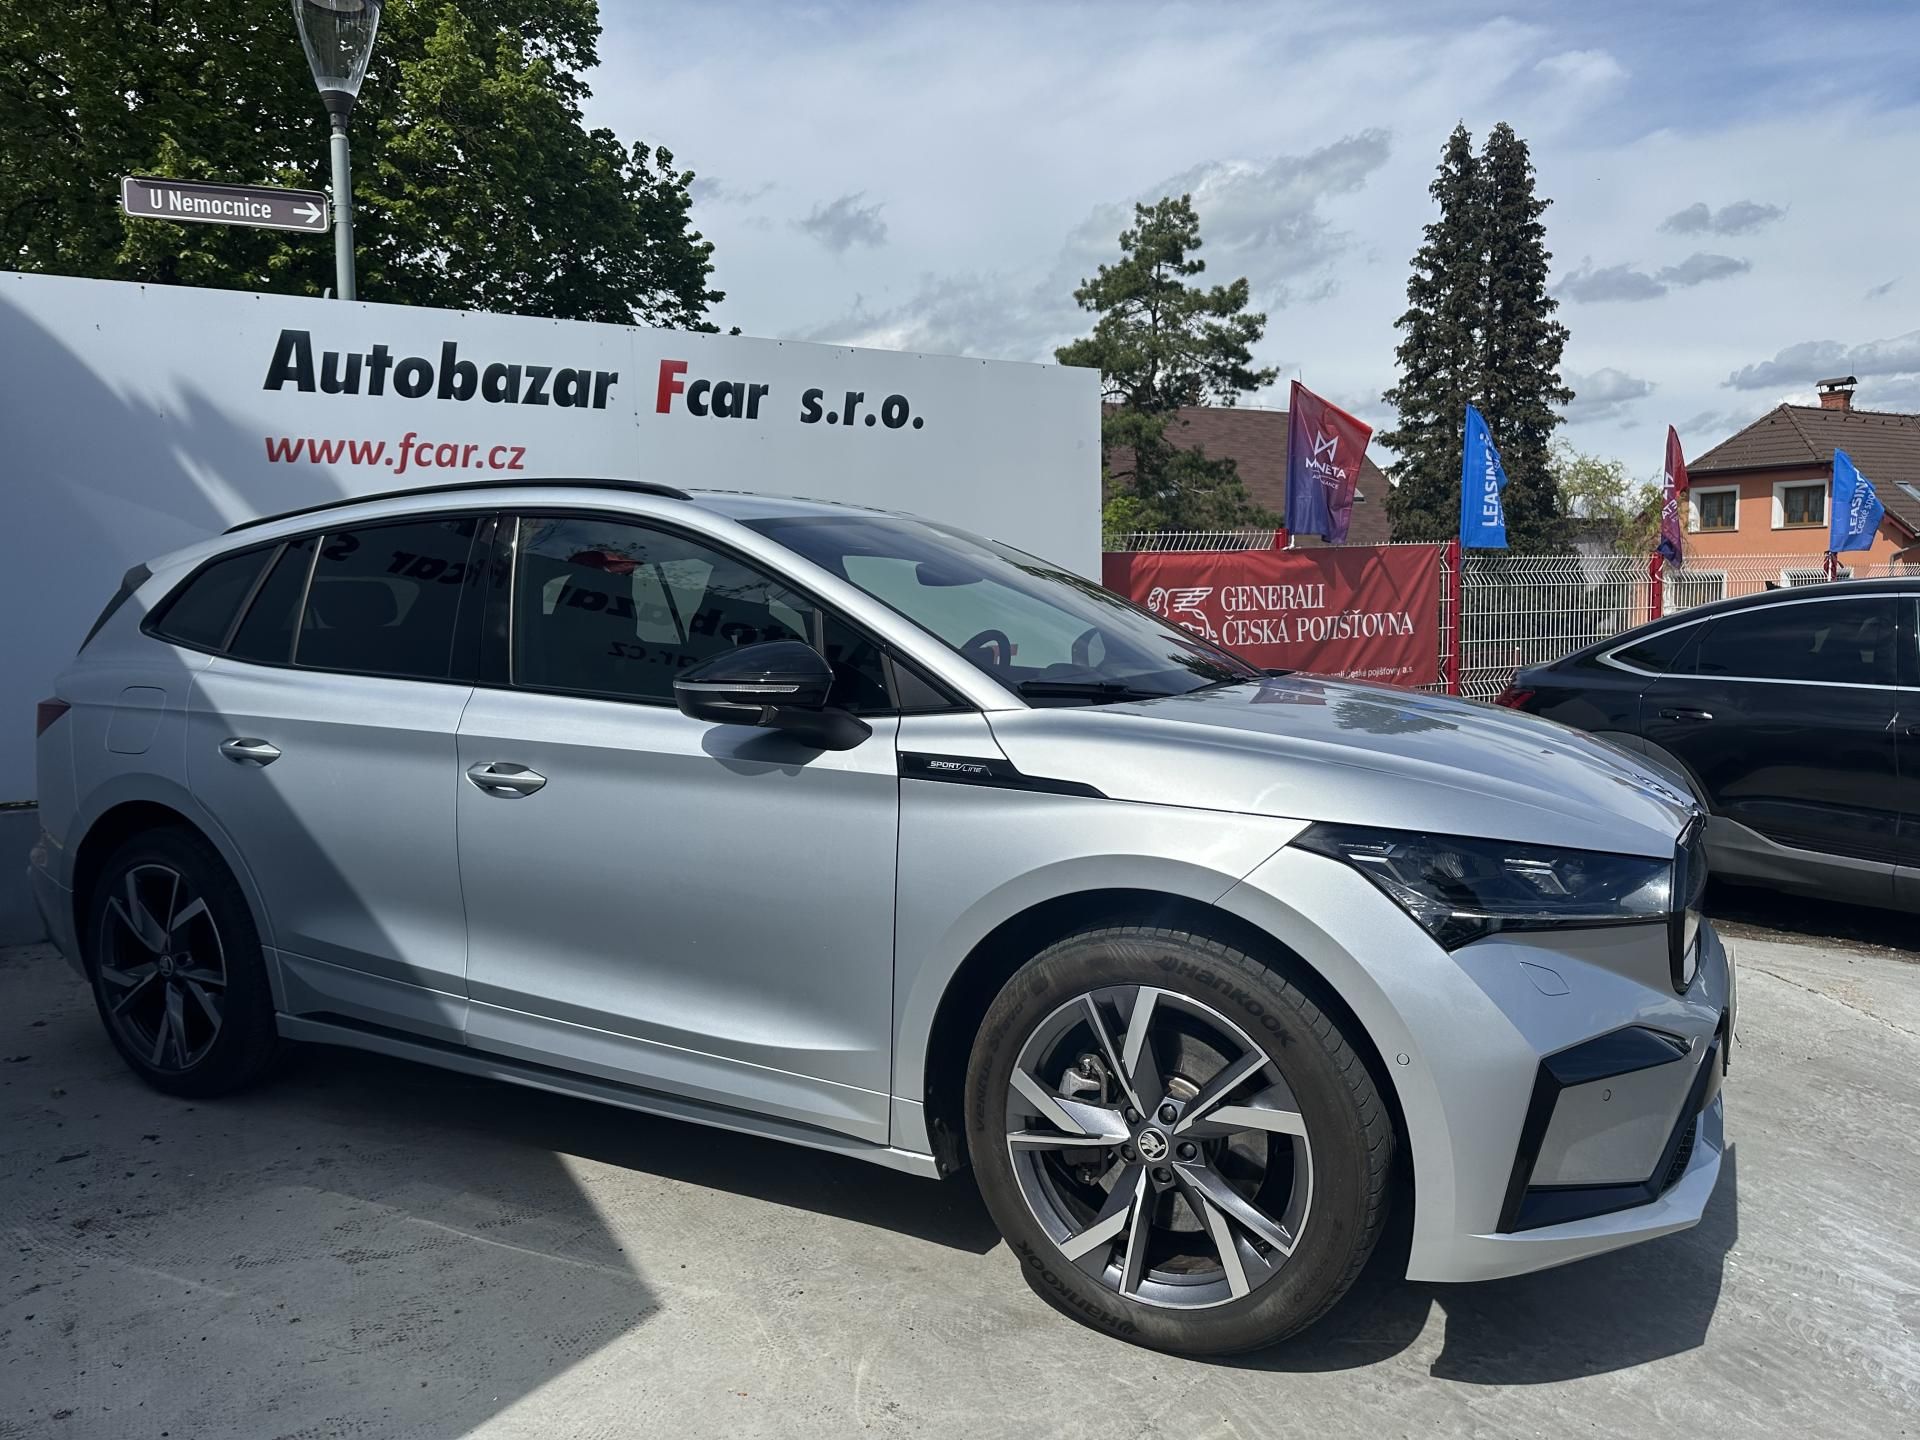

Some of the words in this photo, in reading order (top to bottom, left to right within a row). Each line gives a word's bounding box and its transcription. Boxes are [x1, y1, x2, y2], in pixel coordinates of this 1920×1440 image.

[151, 189, 162, 209] U
[169, 190, 272, 219] Nemocnice
[263, 329, 619, 410] Autobazar
[656, 359, 769, 420] Fcar
[800, 388, 924, 429] s.r.o.
[265, 432, 526, 475] www.fcar.cz
[1305, 456, 1347, 479] MNETA
[1221, 584, 1325, 612] GENERALI
[1222, 613, 1291, 646] ČESKÁ
[1296, 609, 1414, 642] POJIŠŤOVNA
